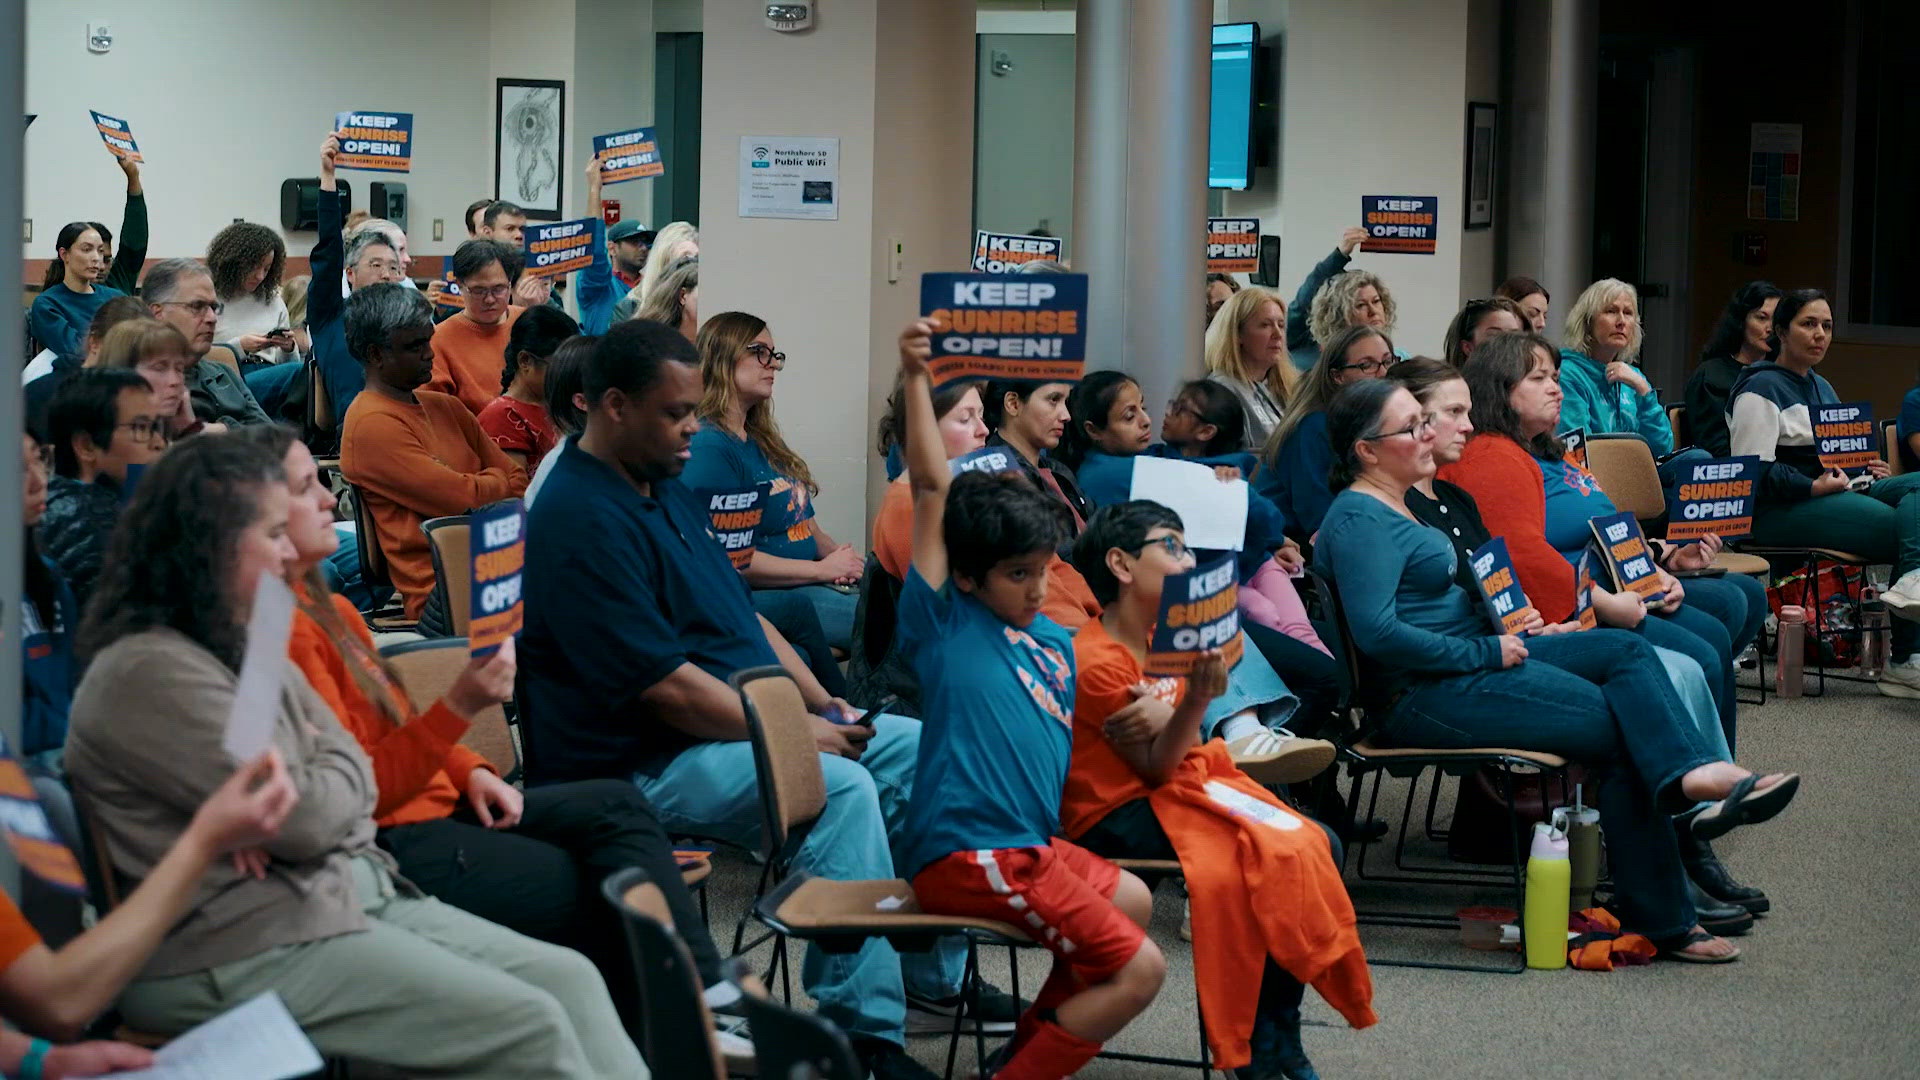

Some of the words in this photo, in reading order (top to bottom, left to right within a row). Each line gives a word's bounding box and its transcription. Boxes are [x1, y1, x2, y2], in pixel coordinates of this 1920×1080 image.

[350, 115, 399, 128] KEEP
[340, 127, 408, 143] SUNRISE
[605, 131, 644, 148] KEEP
[344, 141, 401, 156] OPEN!
[605, 153, 653, 170] OPEN!
[774, 158, 804, 167] Public
[807, 158, 826, 167] WiFi
[1377, 199, 1423, 211] KEEP
[1367, 211, 1433, 225] SUNRISE
[540, 223, 584, 240] KEEP
[1208, 221, 1255, 233] EEP
[1373, 225, 1427, 238] OPEN!
[530, 233, 593, 254] SUNRISE
[990, 237, 1056, 255] KEEP
[1208, 244, 1257, 258] PEN!
[536, 246, 587, 266] OPEN!
[953, 282, 1056, 307] KEEP
[931, 309, 1077, 334] SUNRISE
[942, 336, 1063, 359] OPEN!
[1820, 408, 1860, 422] KEEP
[1815, 421, 1872, 437] SUNRISE
[1821, 438, 1868, 453] OPEN!
[1692, 463, 1744, 481] KEEP
[1679, 480, 1752, 501] SUNRISE
[710, 492, 758, 510] KEEP
[1684, 499, 1744, 520] OPEN!
[1605, 521, 1628, 542] KEEP
